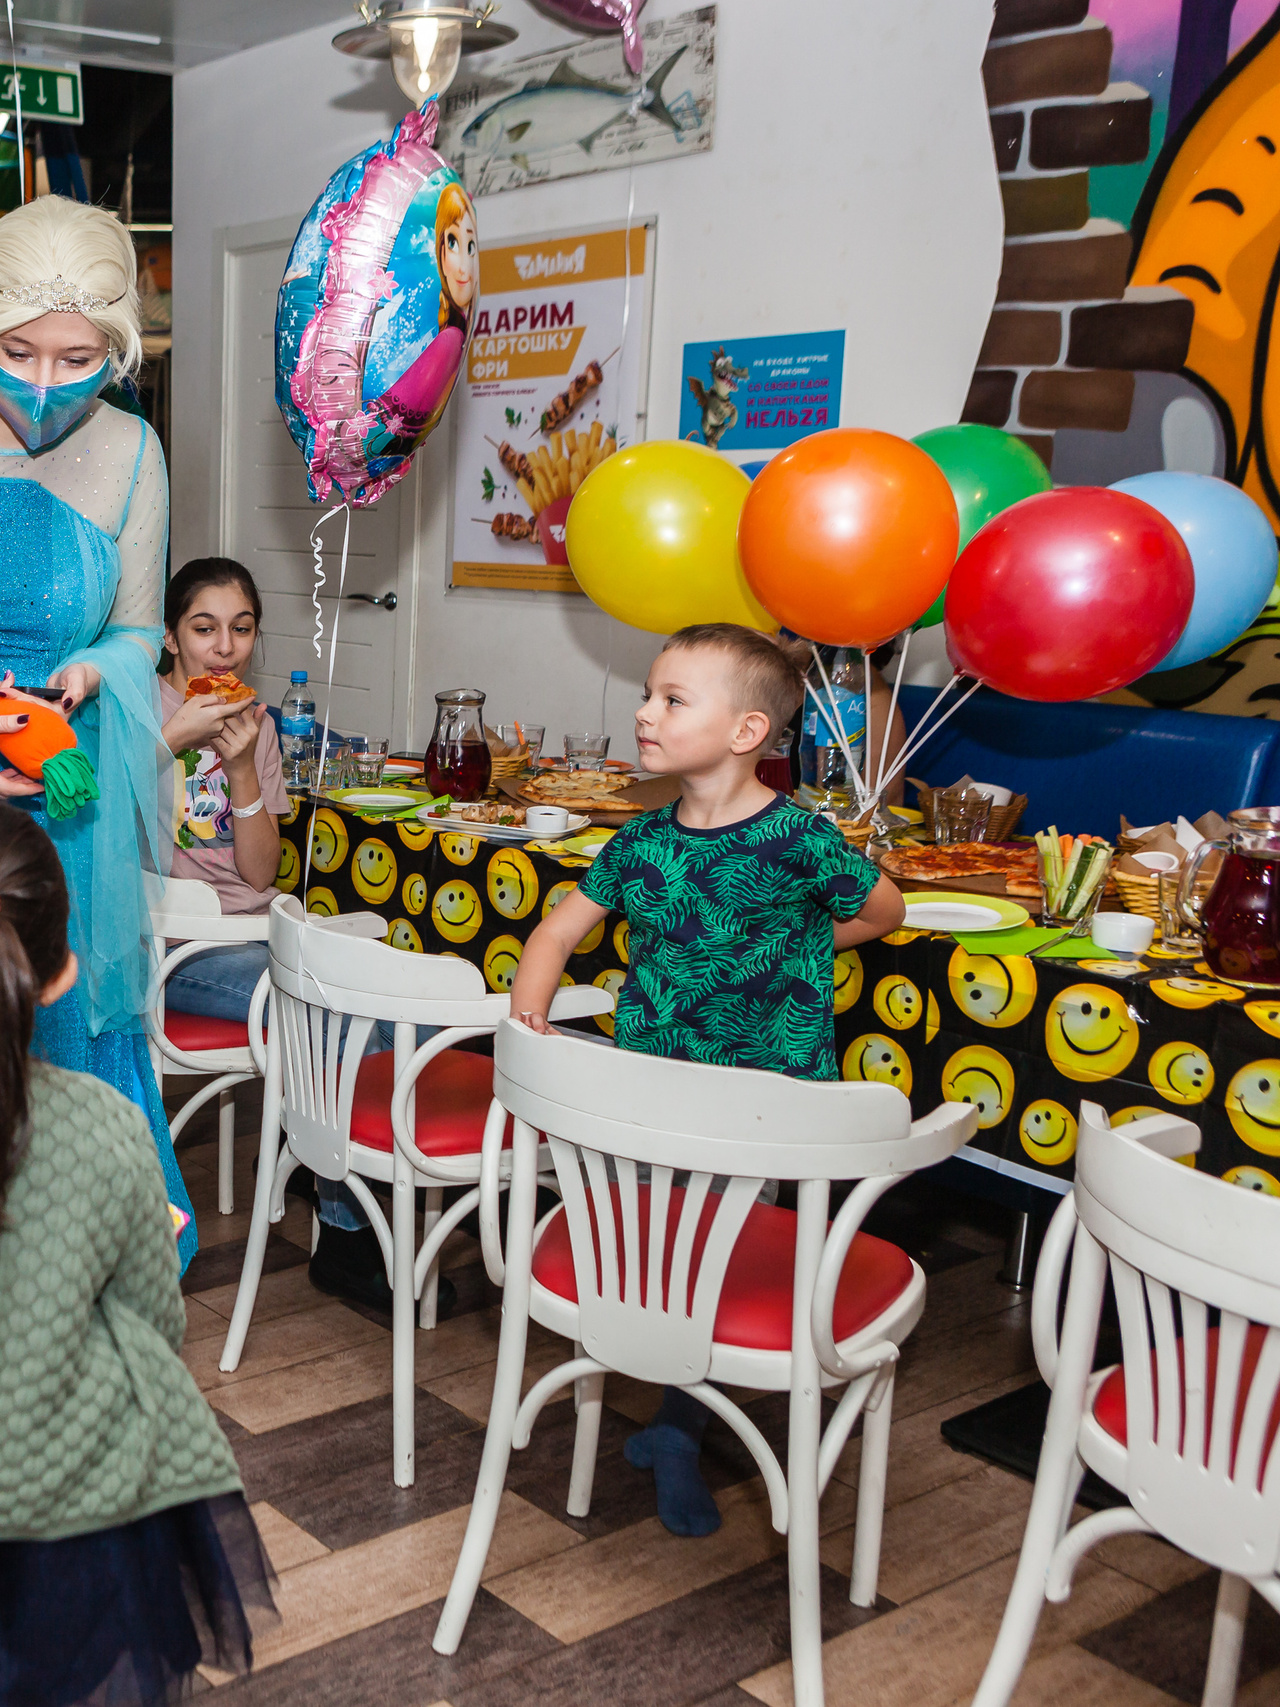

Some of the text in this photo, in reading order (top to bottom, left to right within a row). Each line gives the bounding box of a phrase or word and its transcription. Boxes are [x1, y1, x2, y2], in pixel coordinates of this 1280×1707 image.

[473, 301, 574, 337] ДАРИМ
[473, 332, 573, 358] КАРТОШКУ
[472, 360, 509, 379] ФРИ
